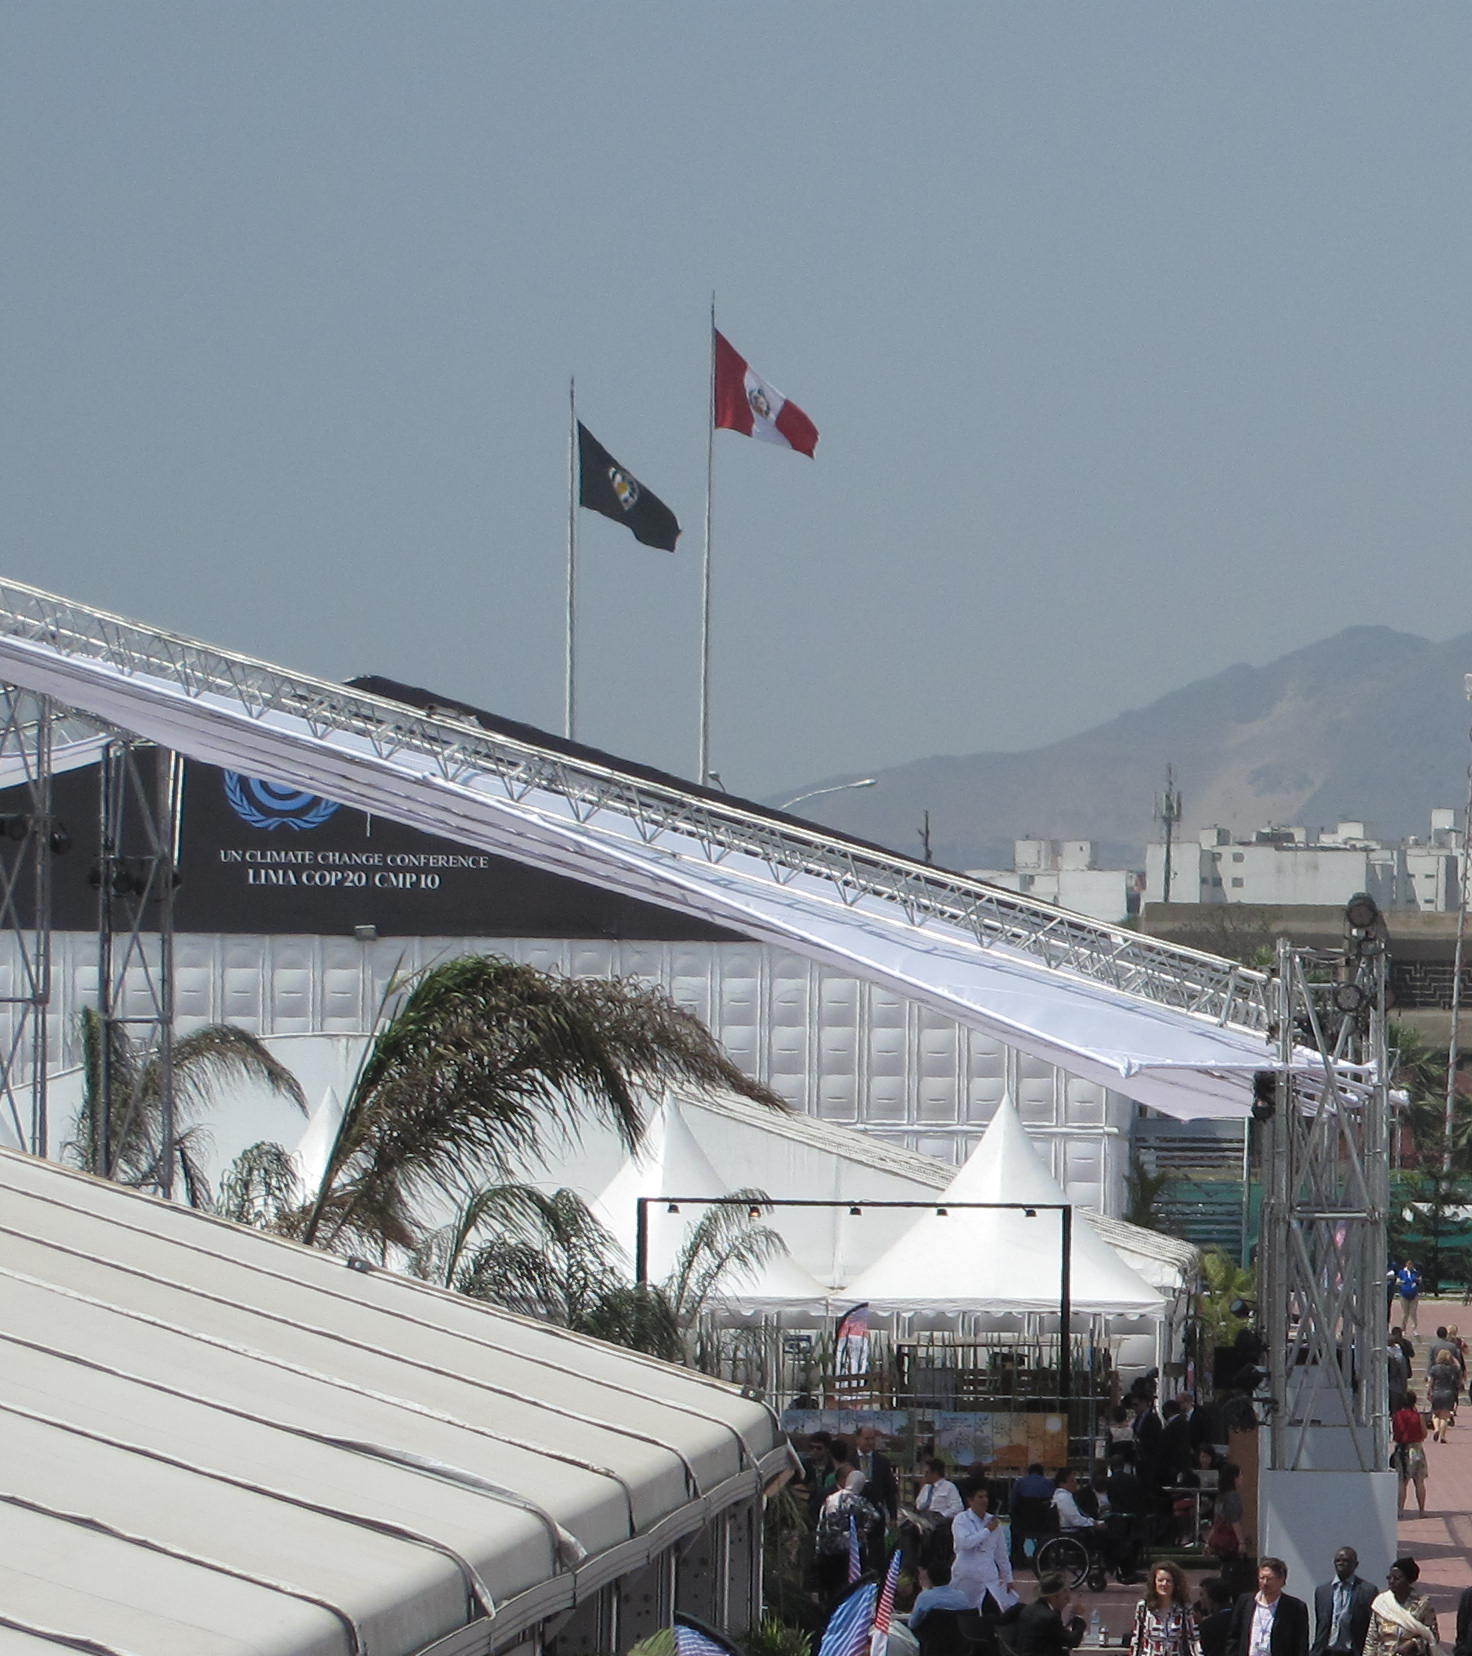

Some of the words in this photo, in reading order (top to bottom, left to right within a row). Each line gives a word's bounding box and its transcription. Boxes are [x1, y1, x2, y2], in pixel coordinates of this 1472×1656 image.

[220, 850, 241, 863] UN
[246, 850, 314, 865] CLIMATE
[317, 852, 383, 867] CHANGE
[387, 854, 489, 868] CONFERENCE
[248, 868, 297, 886] LIMA
[301, 870, 367, 888] COP20
